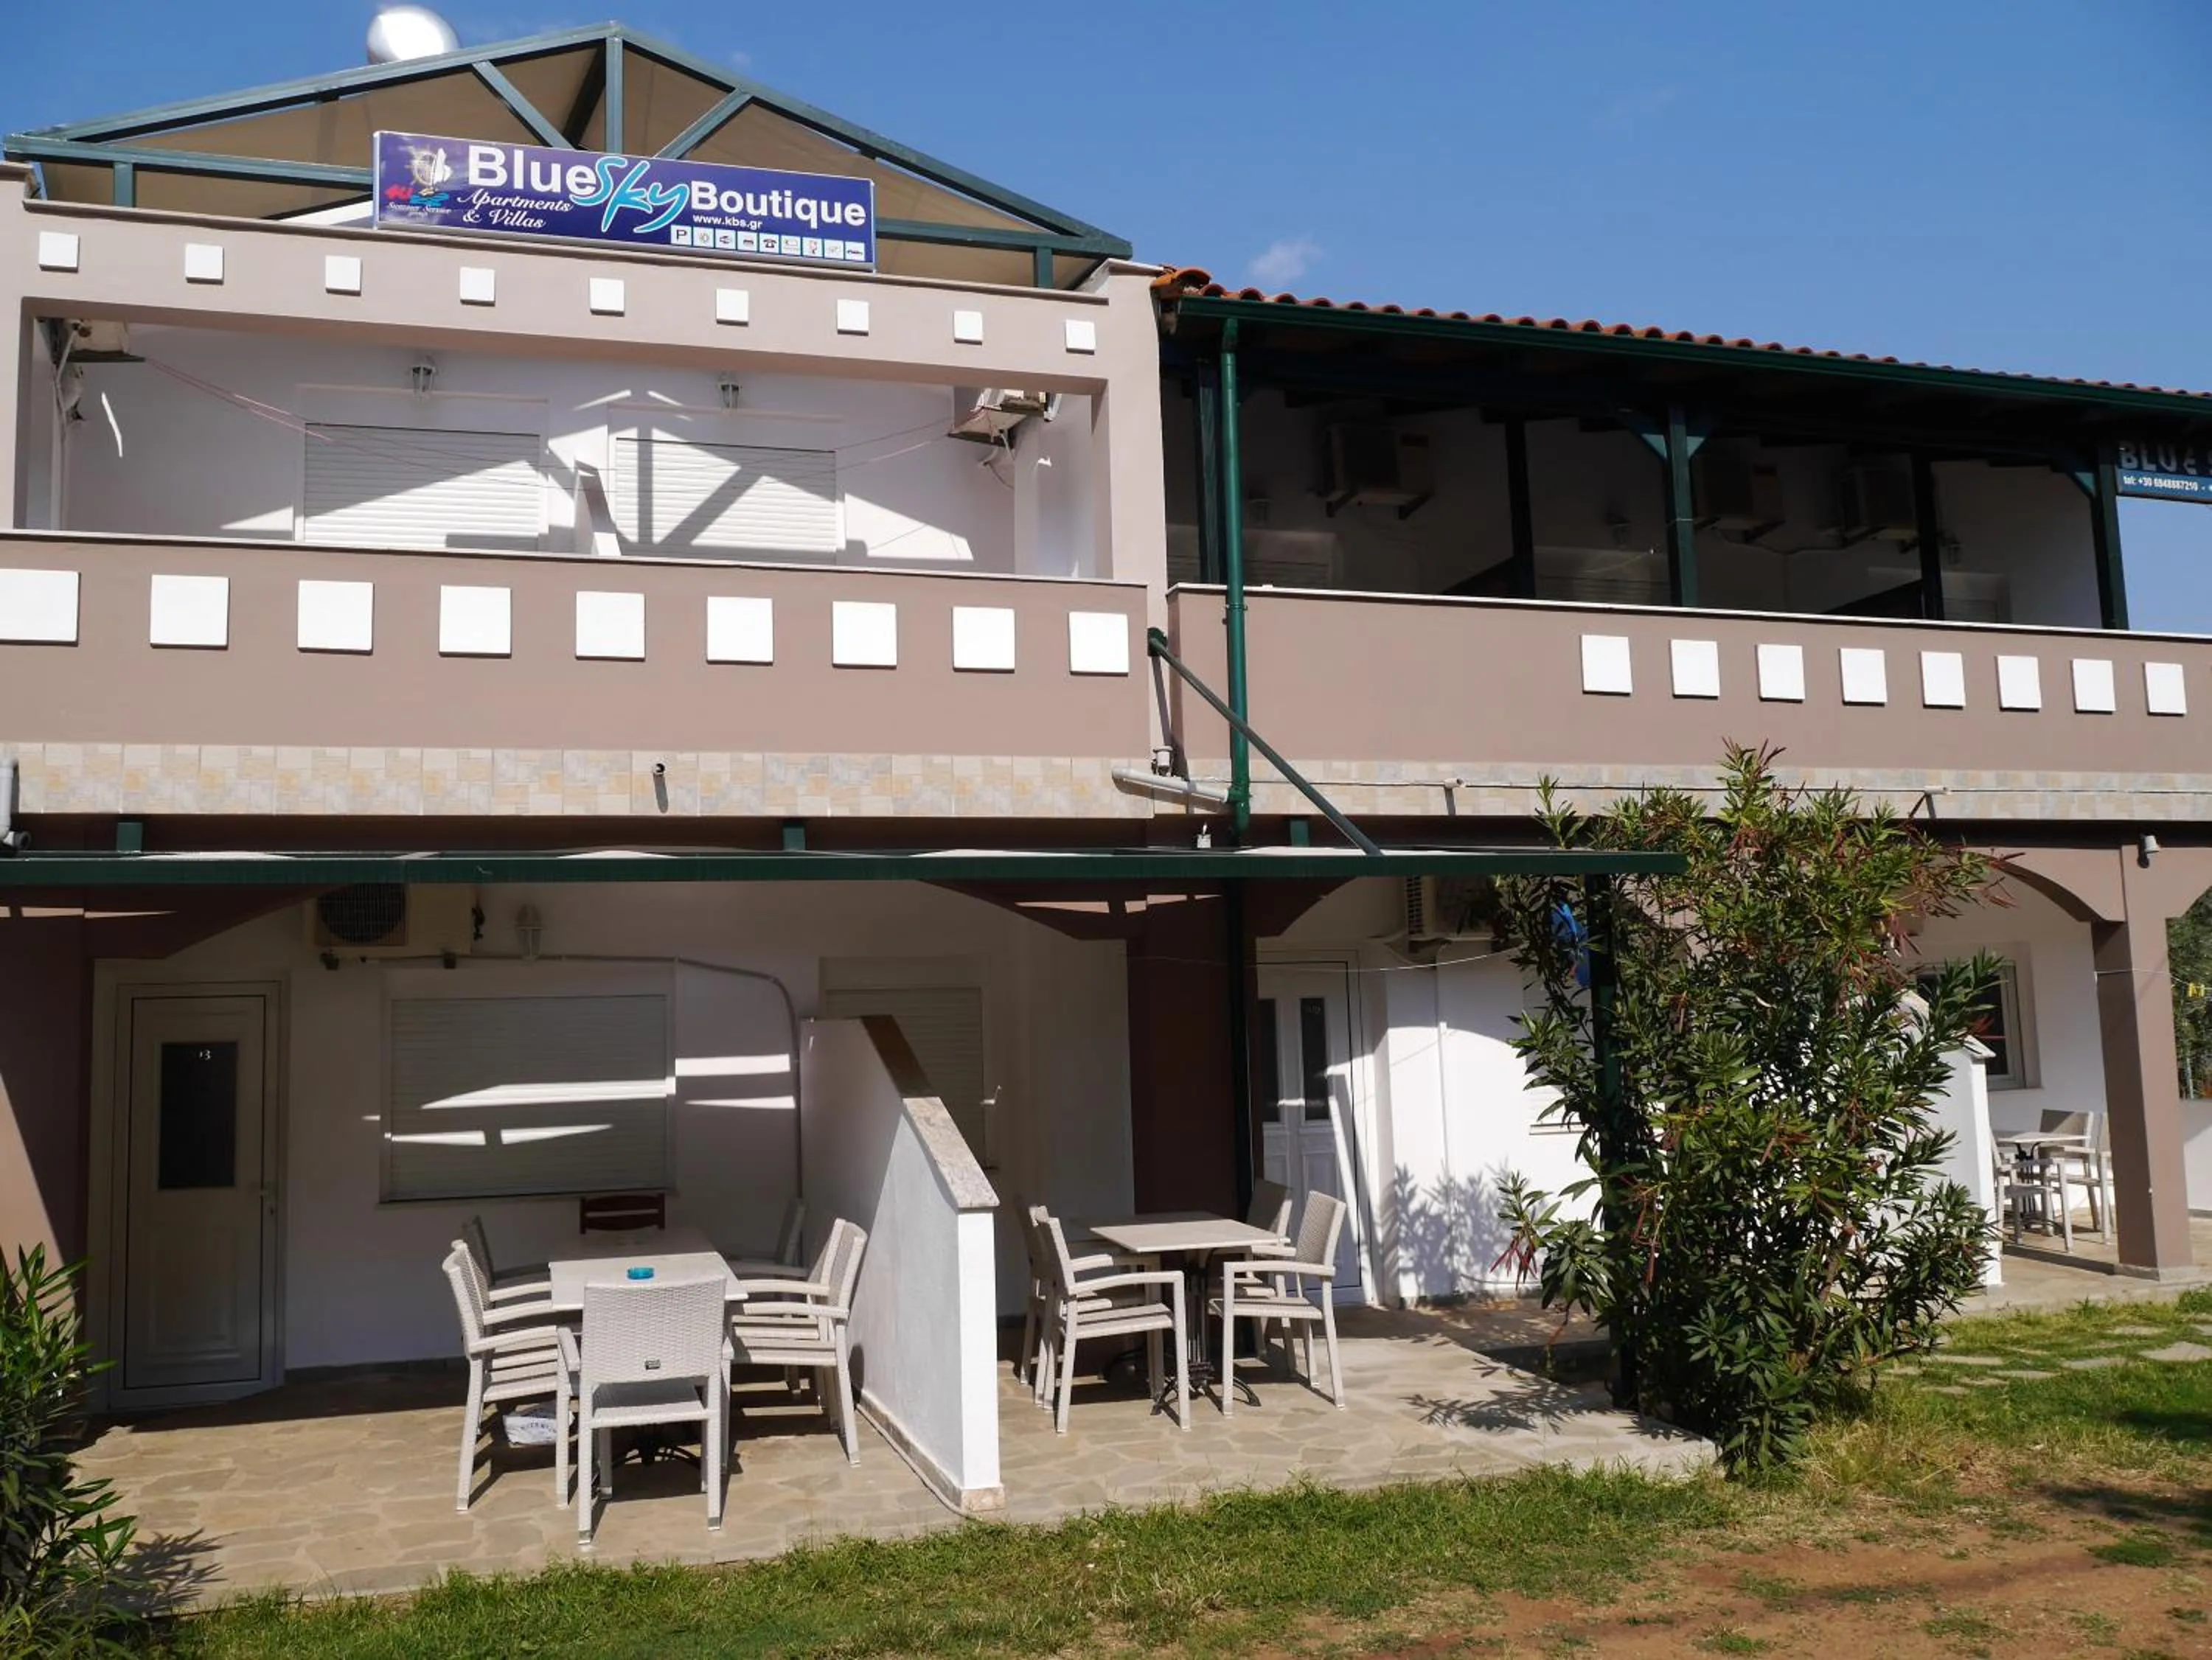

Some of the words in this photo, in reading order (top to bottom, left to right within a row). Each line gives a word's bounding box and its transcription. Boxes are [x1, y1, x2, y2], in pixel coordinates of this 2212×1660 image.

[469, 145, 596, 195] Blue
[569, 156, 689, 233] Sky
[691, 181, 866, 229] Boutique
[457, 189, 574, 212] Apartments
[462, 209, 481, 223] &
[489, 209, 546, 228] Villas
[692, 214, 762, 230] www.kbs.gr
